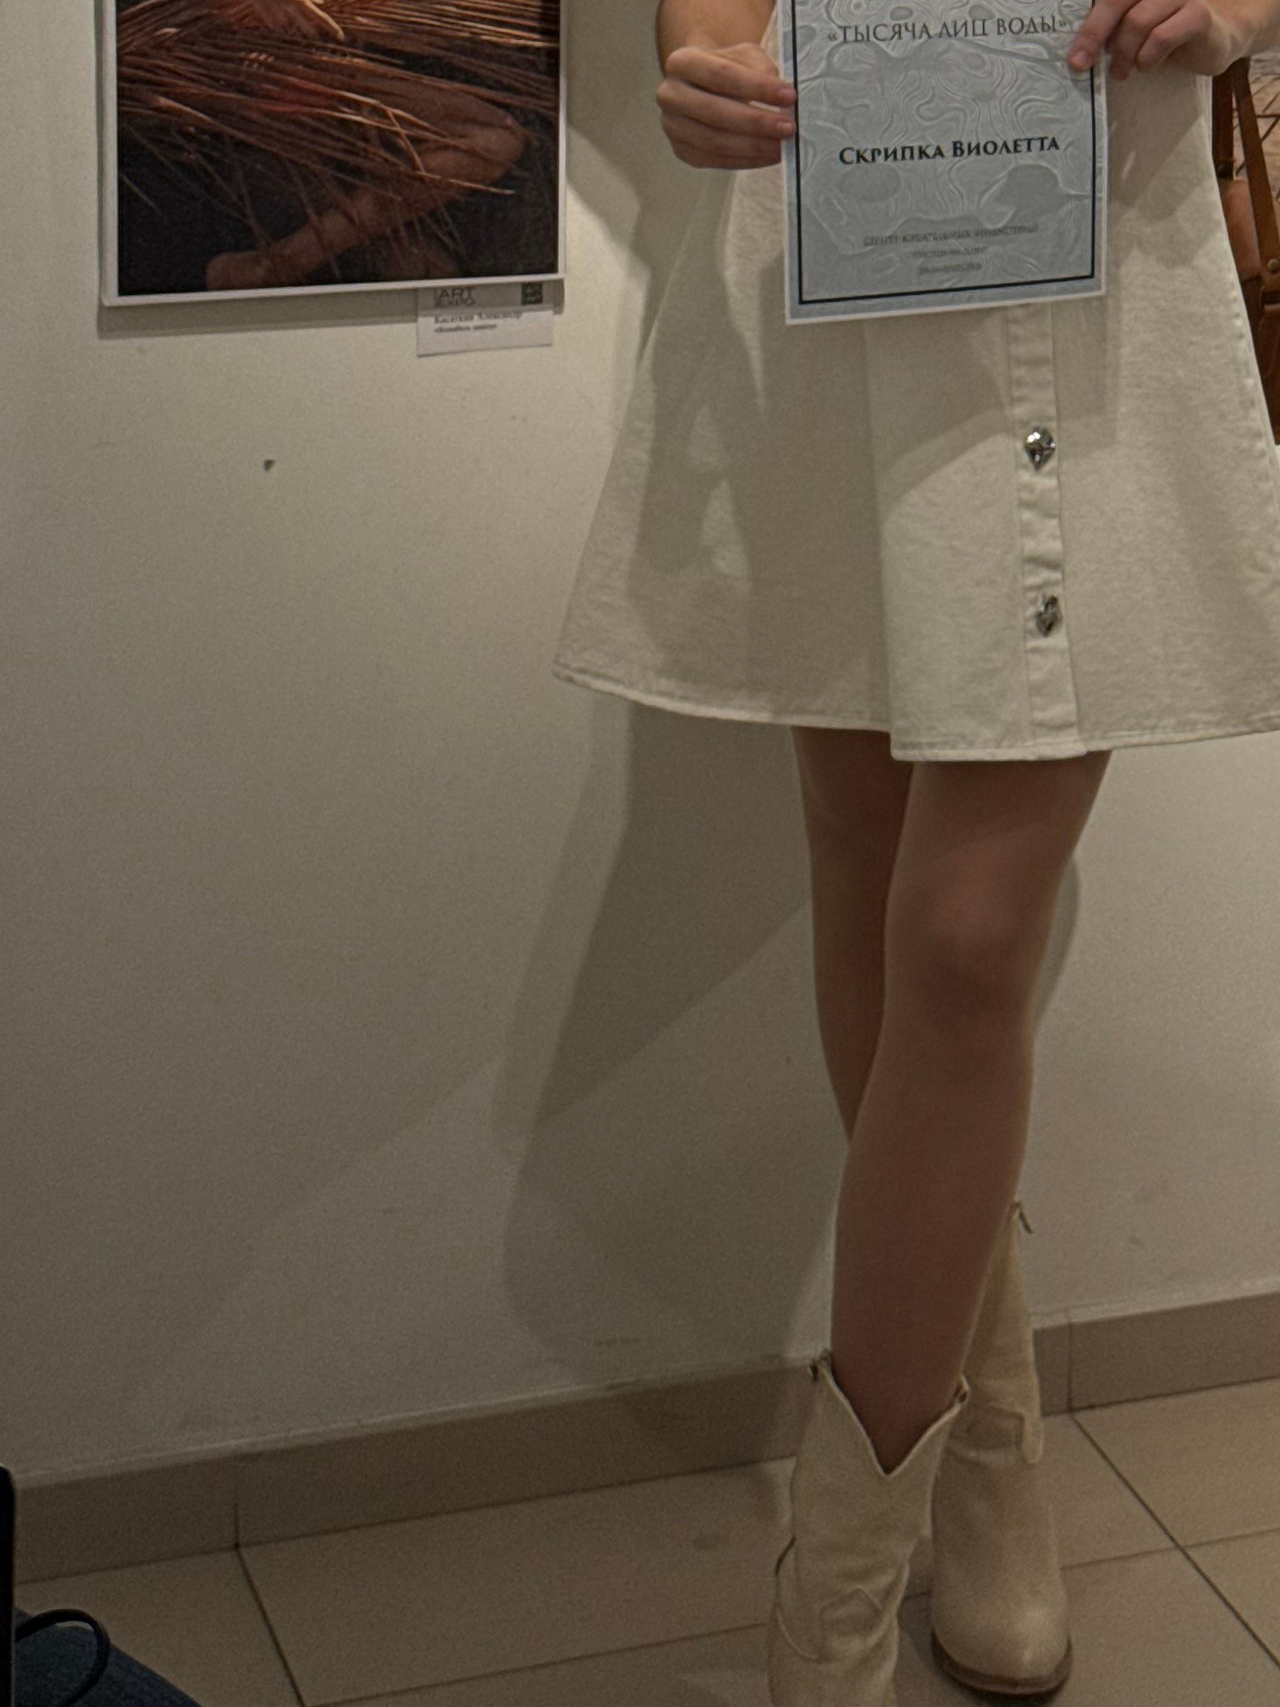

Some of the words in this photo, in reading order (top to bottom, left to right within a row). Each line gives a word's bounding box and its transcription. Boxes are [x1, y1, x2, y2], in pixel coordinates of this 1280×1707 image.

[828, 22, 933, 43] «ТЫСЯЧА
[938, 19, 988, 38] ЛИЦ
[996, 15, 1068, 36] ВОДЫ»
